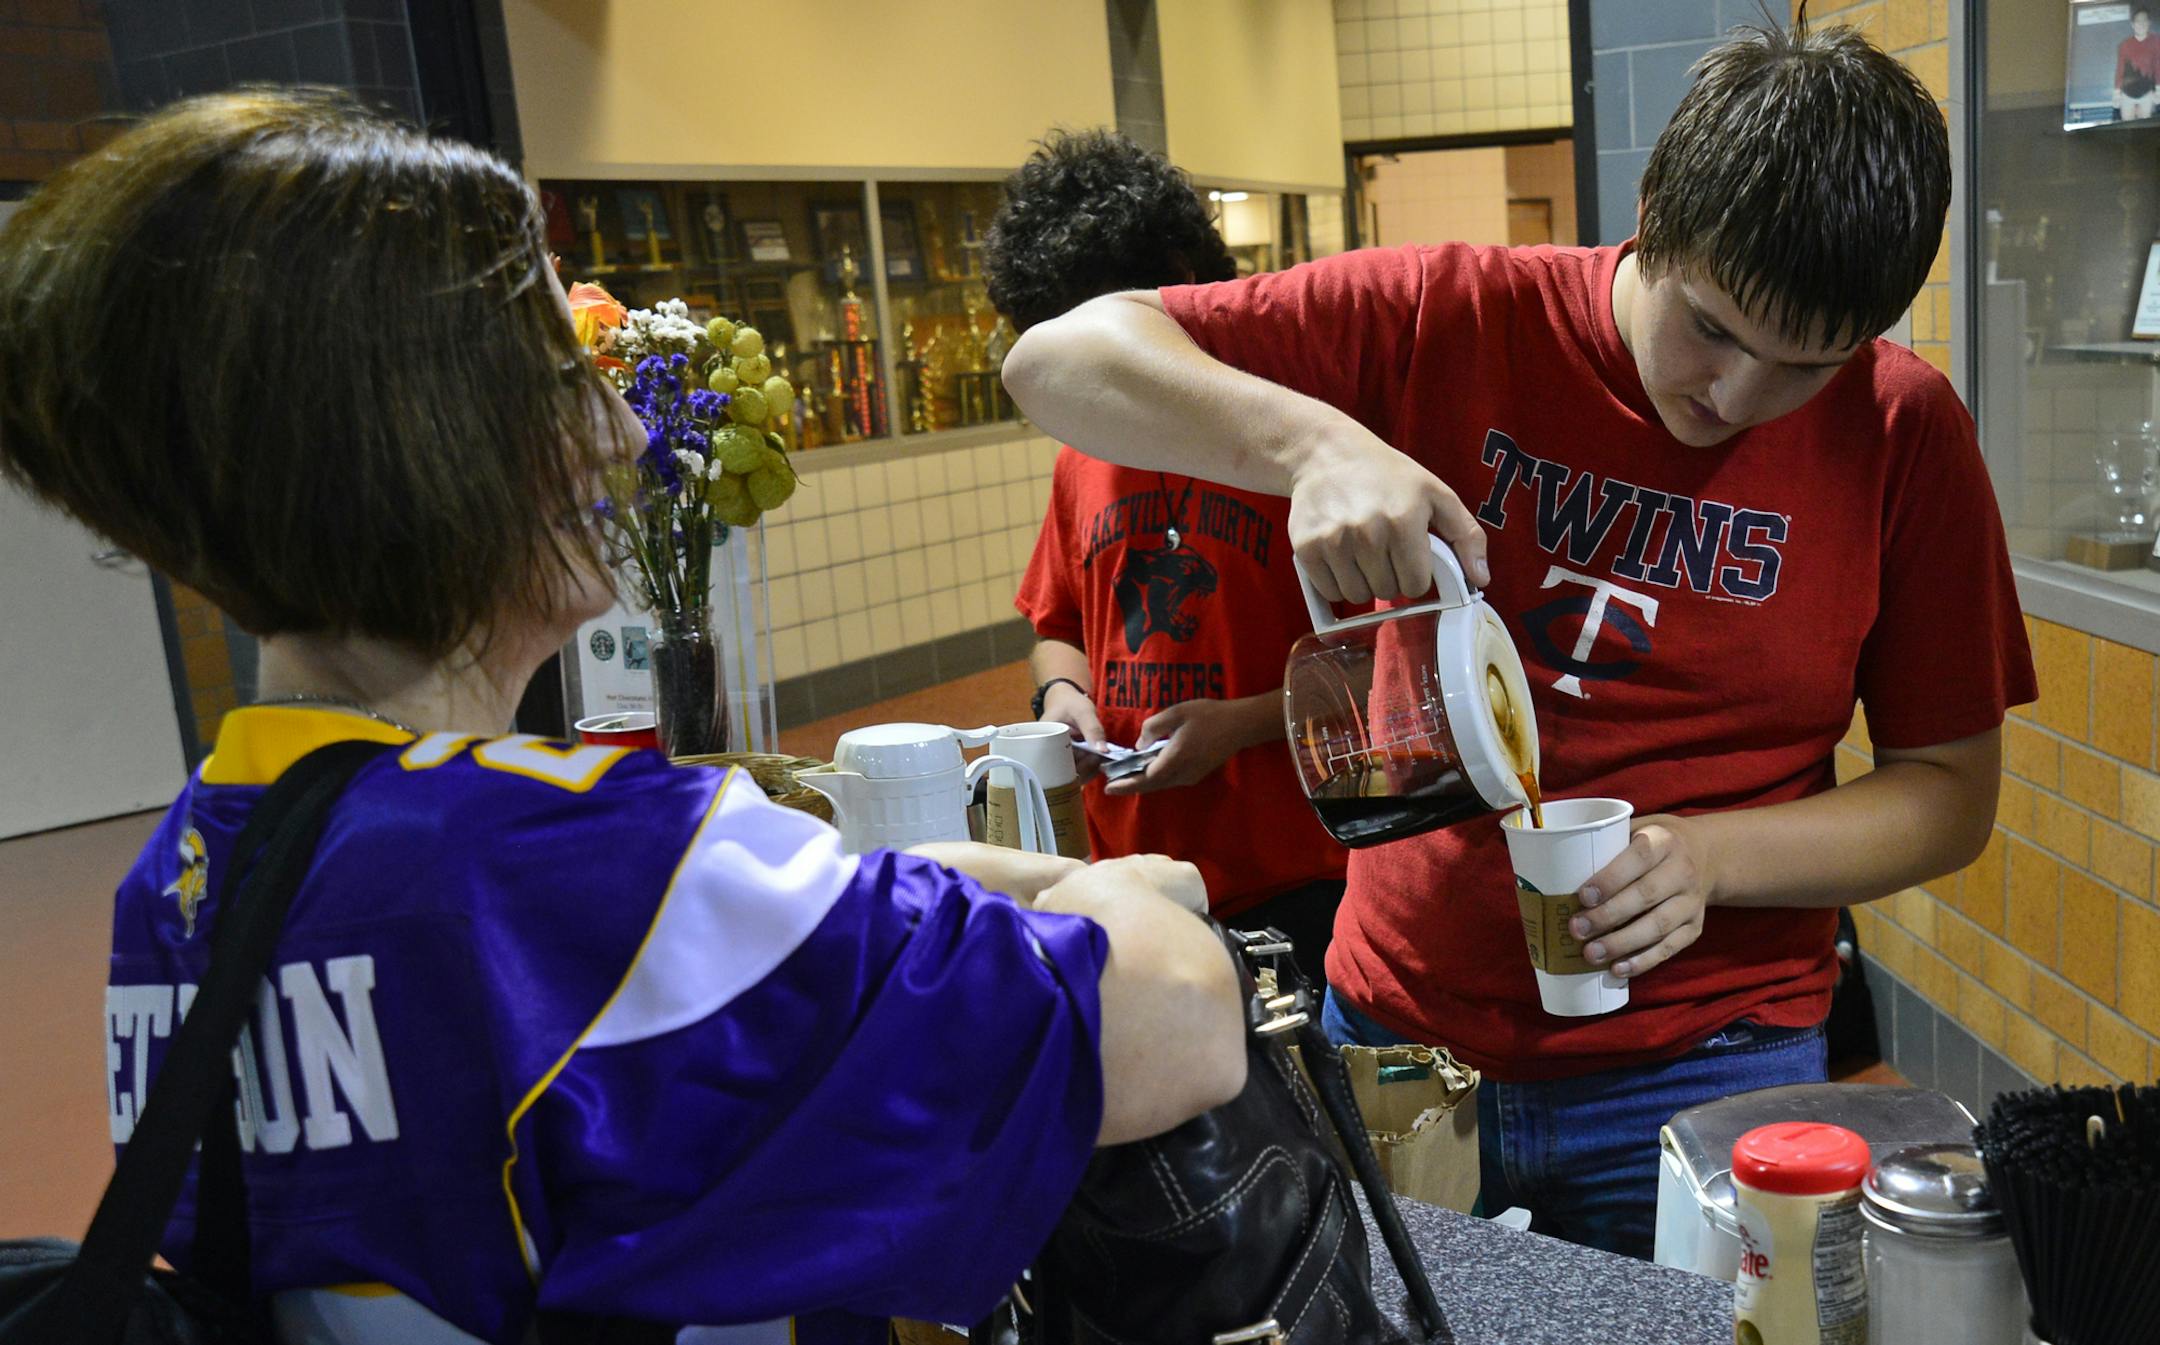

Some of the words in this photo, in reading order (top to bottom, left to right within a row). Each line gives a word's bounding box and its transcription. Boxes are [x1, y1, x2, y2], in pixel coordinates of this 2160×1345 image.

[1197, 489, 1273, 569] NORTH
[1476, 428, 1788, 601] TWINS
[1105, 660, 1224, 708] PANTHERS
